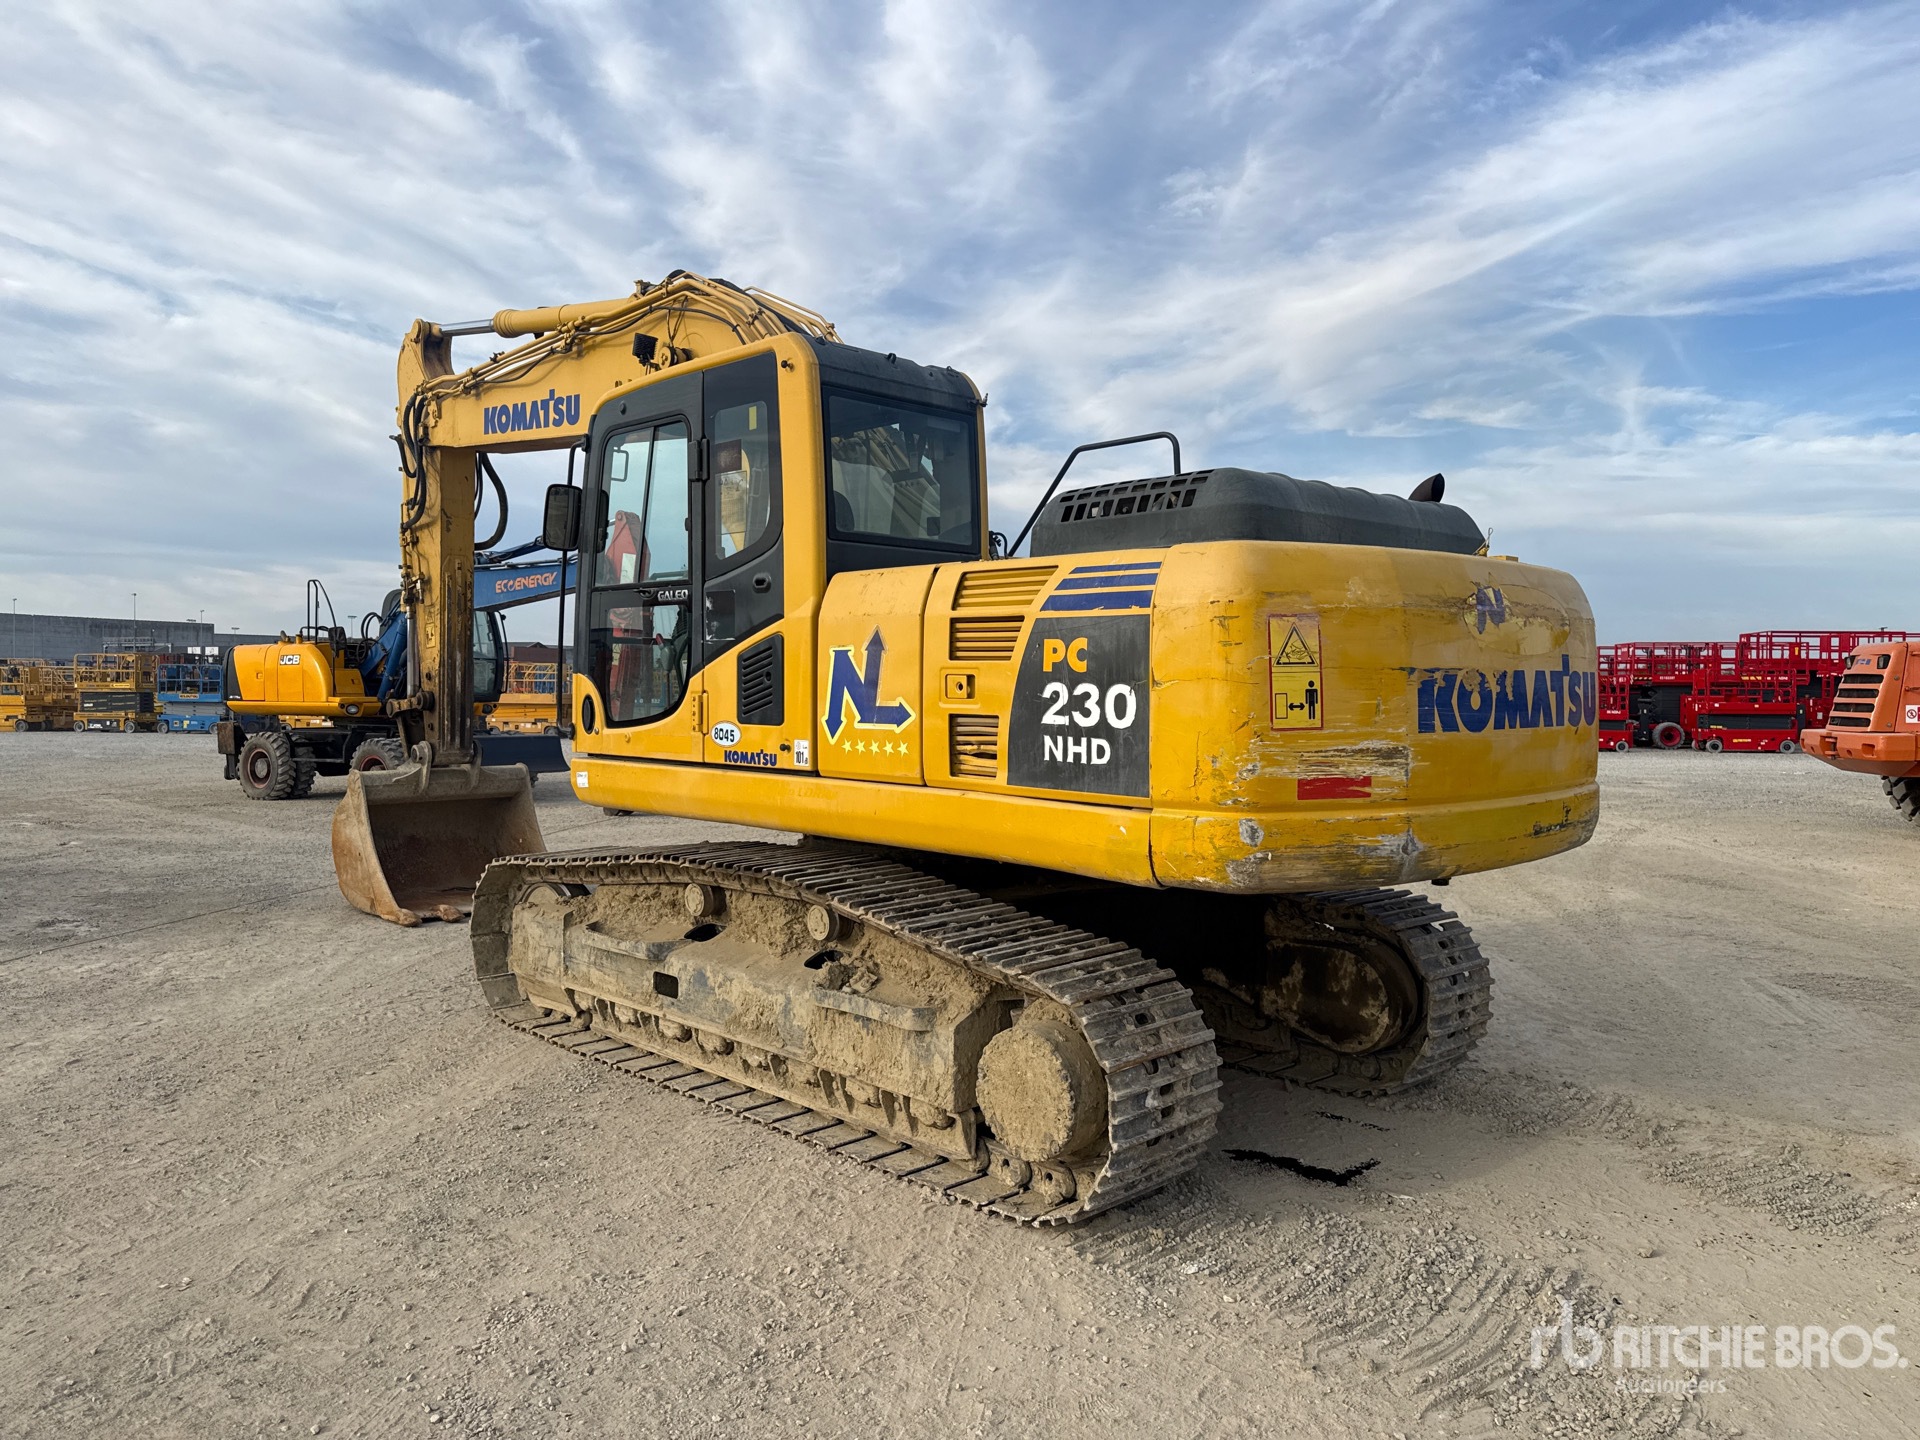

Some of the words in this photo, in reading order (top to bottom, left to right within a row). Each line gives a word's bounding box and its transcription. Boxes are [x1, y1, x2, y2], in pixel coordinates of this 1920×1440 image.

[483, 388, 580, 435] KOMATSU
[495, 571, 558, 594] ECOENERGY
[657, 589, 689, 601] GALEO
[280, 655, 300, 665] JCB
[1042, 637, 1088, 673] PC
[1041, 681, 1137, 729] 230
[1417, 654, 1596, 734] KOMATSU
[713, 727, 735, 743] 8045
[724, 749, 777, 767] KOMATSU
[1043, 735, 1111, 765] NHD
